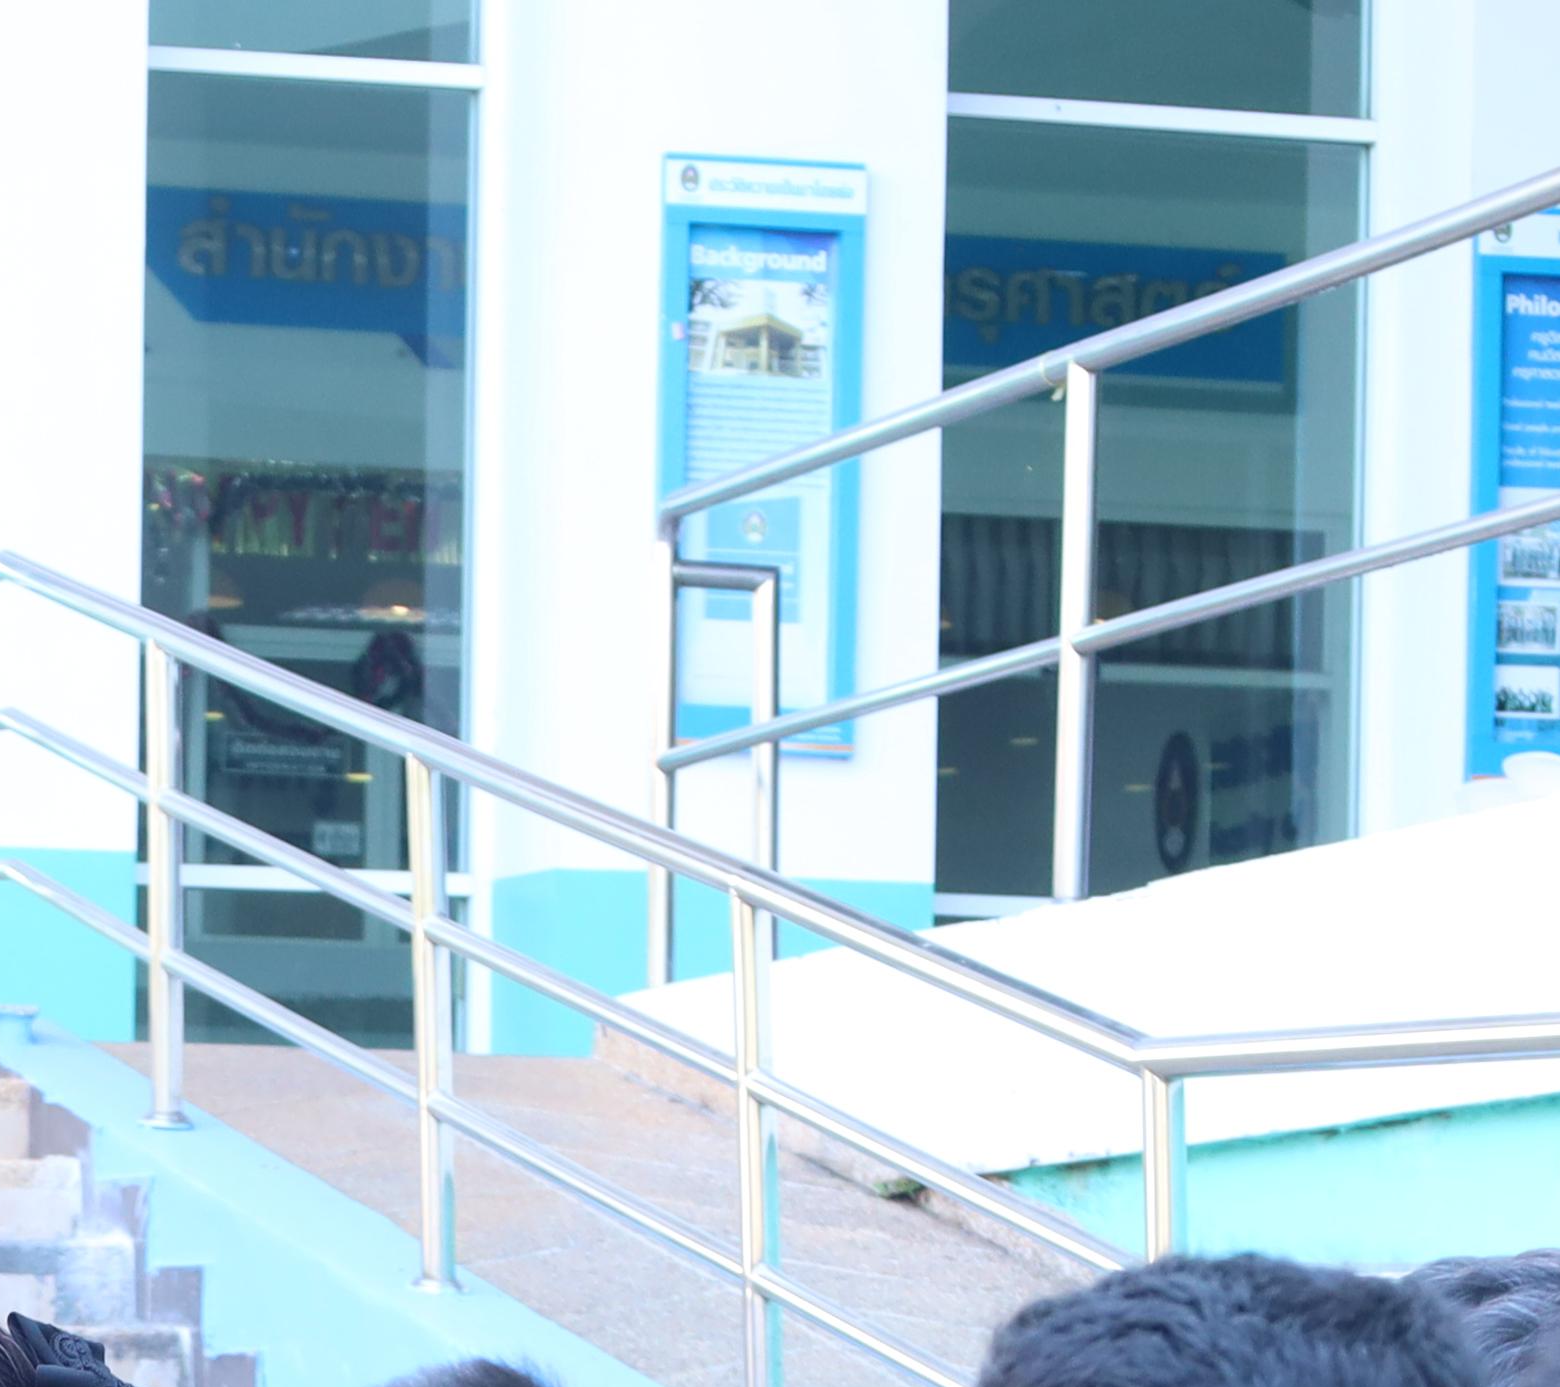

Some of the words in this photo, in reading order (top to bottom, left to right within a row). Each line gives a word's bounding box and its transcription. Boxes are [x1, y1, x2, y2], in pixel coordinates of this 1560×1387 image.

[179, 195, 467, 292] สำนักงา
[691, 243, 828, 273] Background
